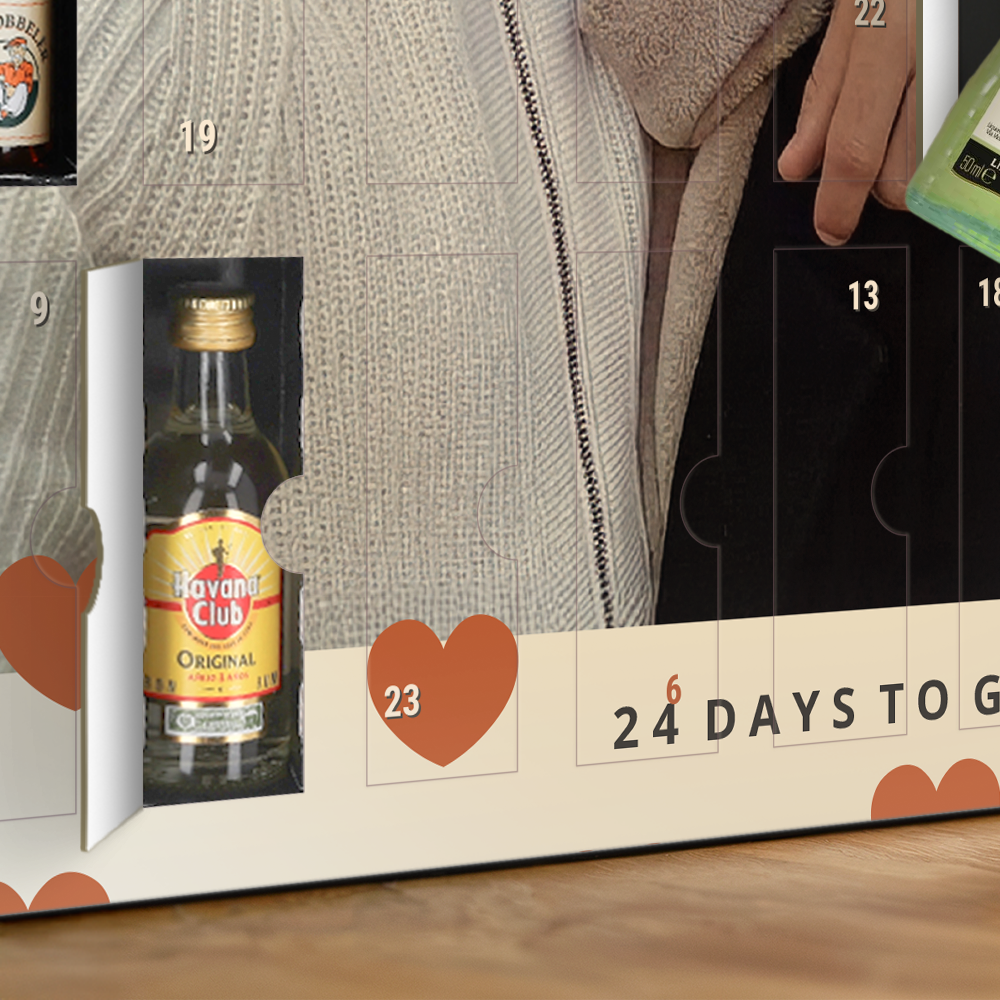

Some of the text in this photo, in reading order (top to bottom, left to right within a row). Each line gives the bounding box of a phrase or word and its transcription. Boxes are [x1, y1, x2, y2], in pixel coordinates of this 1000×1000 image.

[180, 118, 218, 154] 19
[29, 290, 50, 326] 9
[848, 280, 880, 311] 13
[173, 571, 259, 599] Havana
[192, 601, 243, 627] Club
[176, 649, 257, 670] ORIGINAL
[384, 683, 422, 720] 23
[666, 674, 682, 704] 6
[613, 705, 679, 750] 24
[707, 686, 856, 740] DAYS
[879, 679, 949, 725] TO
